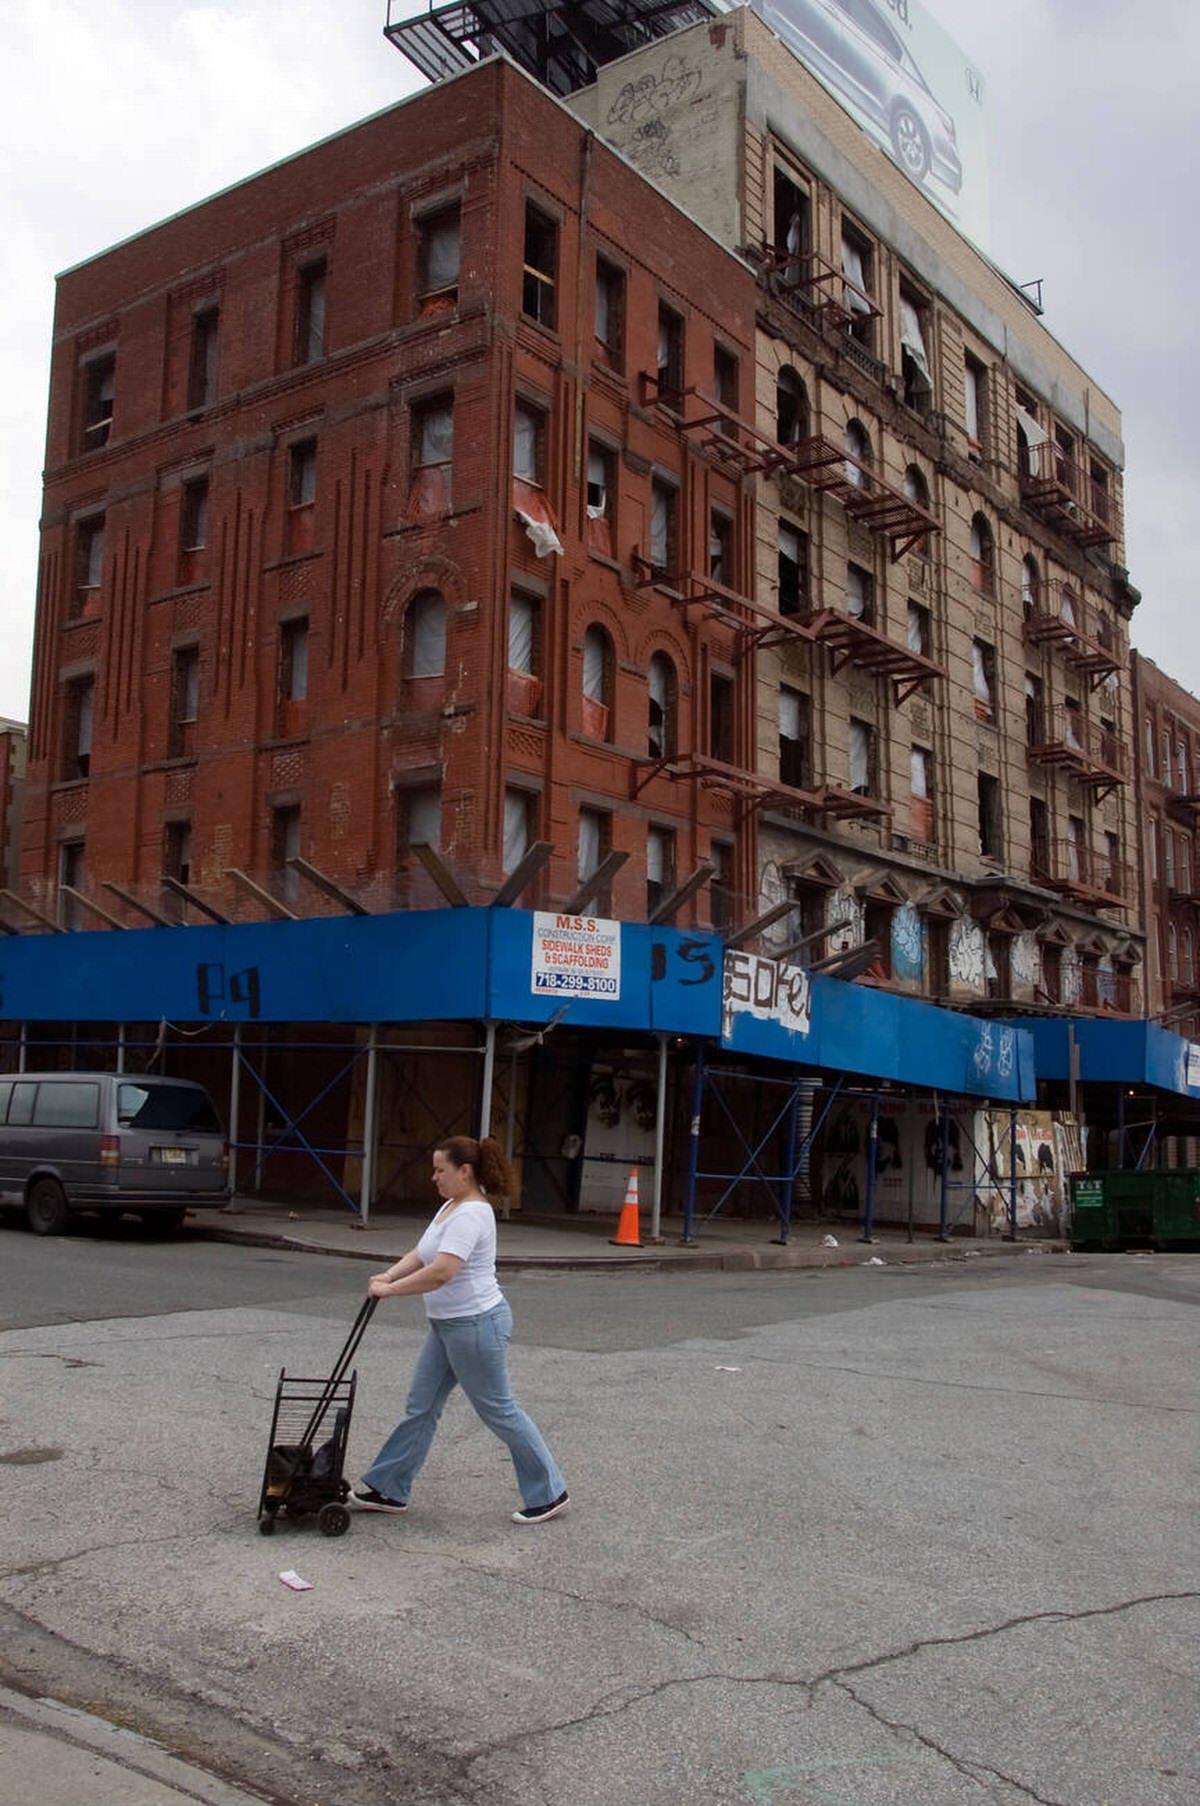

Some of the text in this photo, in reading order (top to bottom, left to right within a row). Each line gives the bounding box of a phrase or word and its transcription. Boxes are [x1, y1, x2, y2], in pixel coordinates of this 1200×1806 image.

[556, 915, 600, 932] M.S.S.
[538, 927, 595, 943] CONSTRUCTION
[542, 939, 612, 957] SIDEWALK SHEDS
[544, 952, 609, 969] & SCAFFOLDING
[537, 973, 615, 992] 718-299-8100
